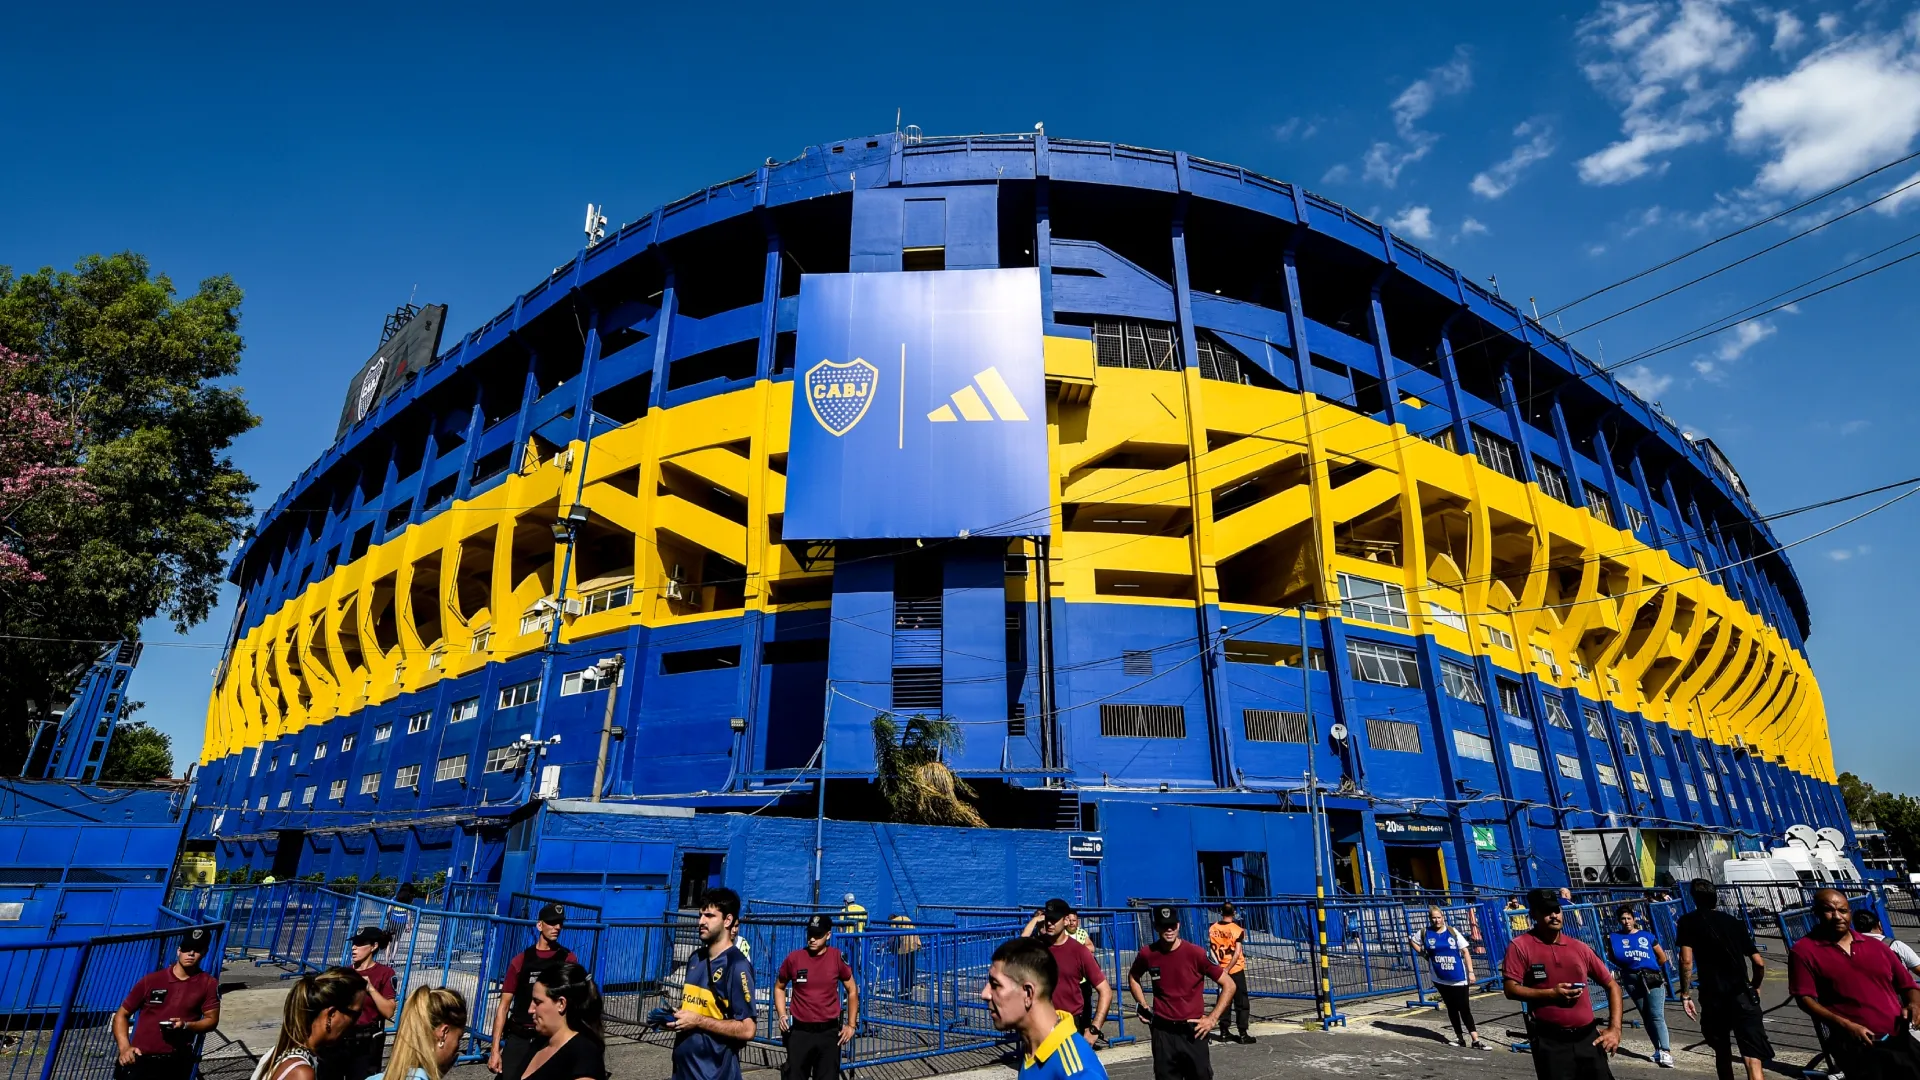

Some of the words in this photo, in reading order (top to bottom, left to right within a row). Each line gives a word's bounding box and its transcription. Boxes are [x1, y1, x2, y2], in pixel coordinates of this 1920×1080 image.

[813, 382, 868, 399] CABJ
[1624, 950, 1651, 959] CONTROL
[1434, 955, 1457, 964] CONTROL
